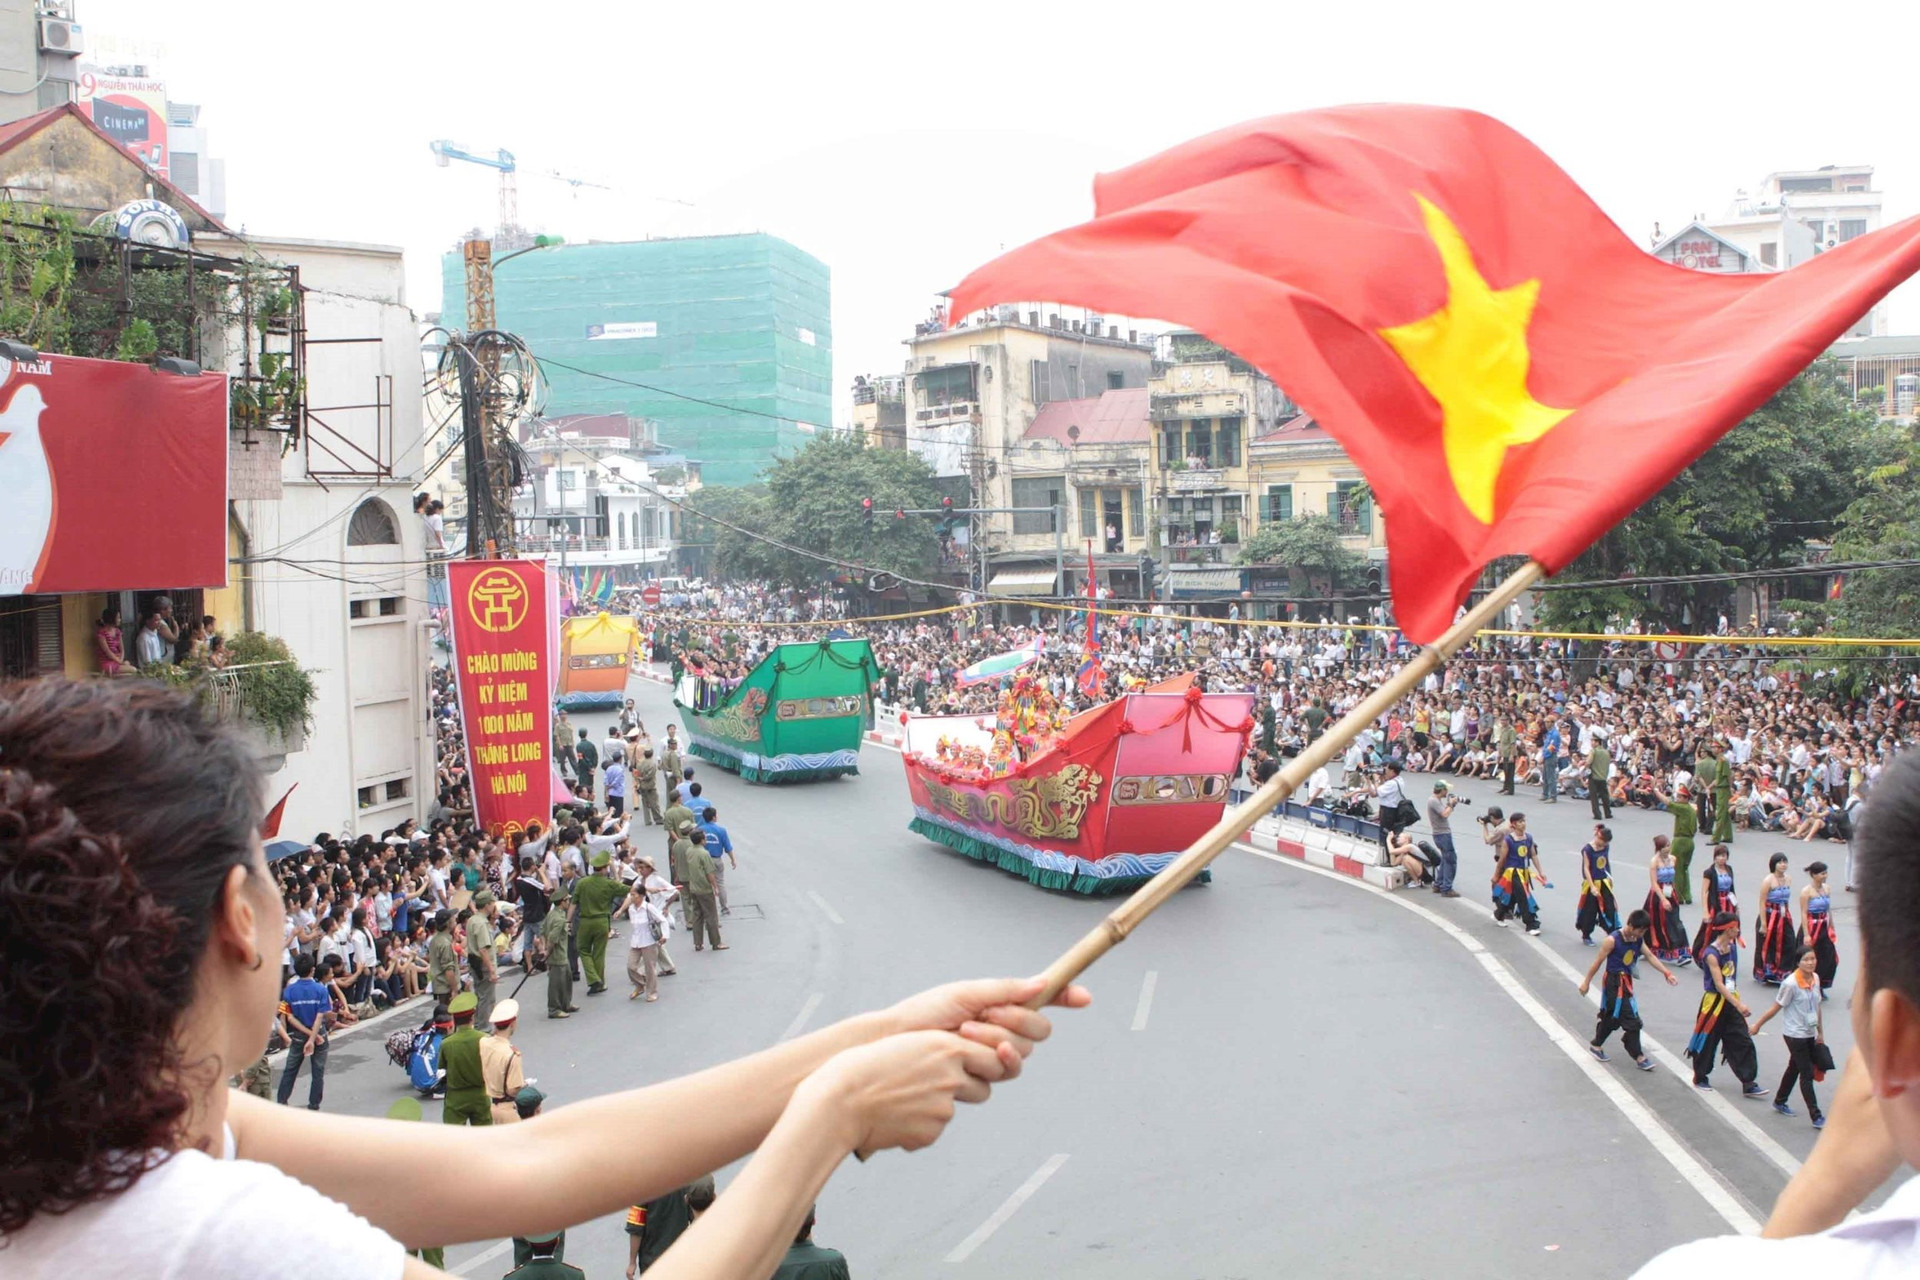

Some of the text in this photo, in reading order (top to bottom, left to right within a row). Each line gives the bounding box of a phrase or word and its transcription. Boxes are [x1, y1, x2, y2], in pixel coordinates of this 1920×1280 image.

[80, 71, 97, 97] 9
[104, 116, 139, 130] CINEMA
[467, 648, 538, 674] CHÀO MỪNG
[479, 677, 528, 706] KỶ NIỆM
[477, 709, 534, 735] 1000 NĂM
[474, 742, 542, 765] THĂNG LONG
[491, 770, 527, 796] HÀ NỘI
